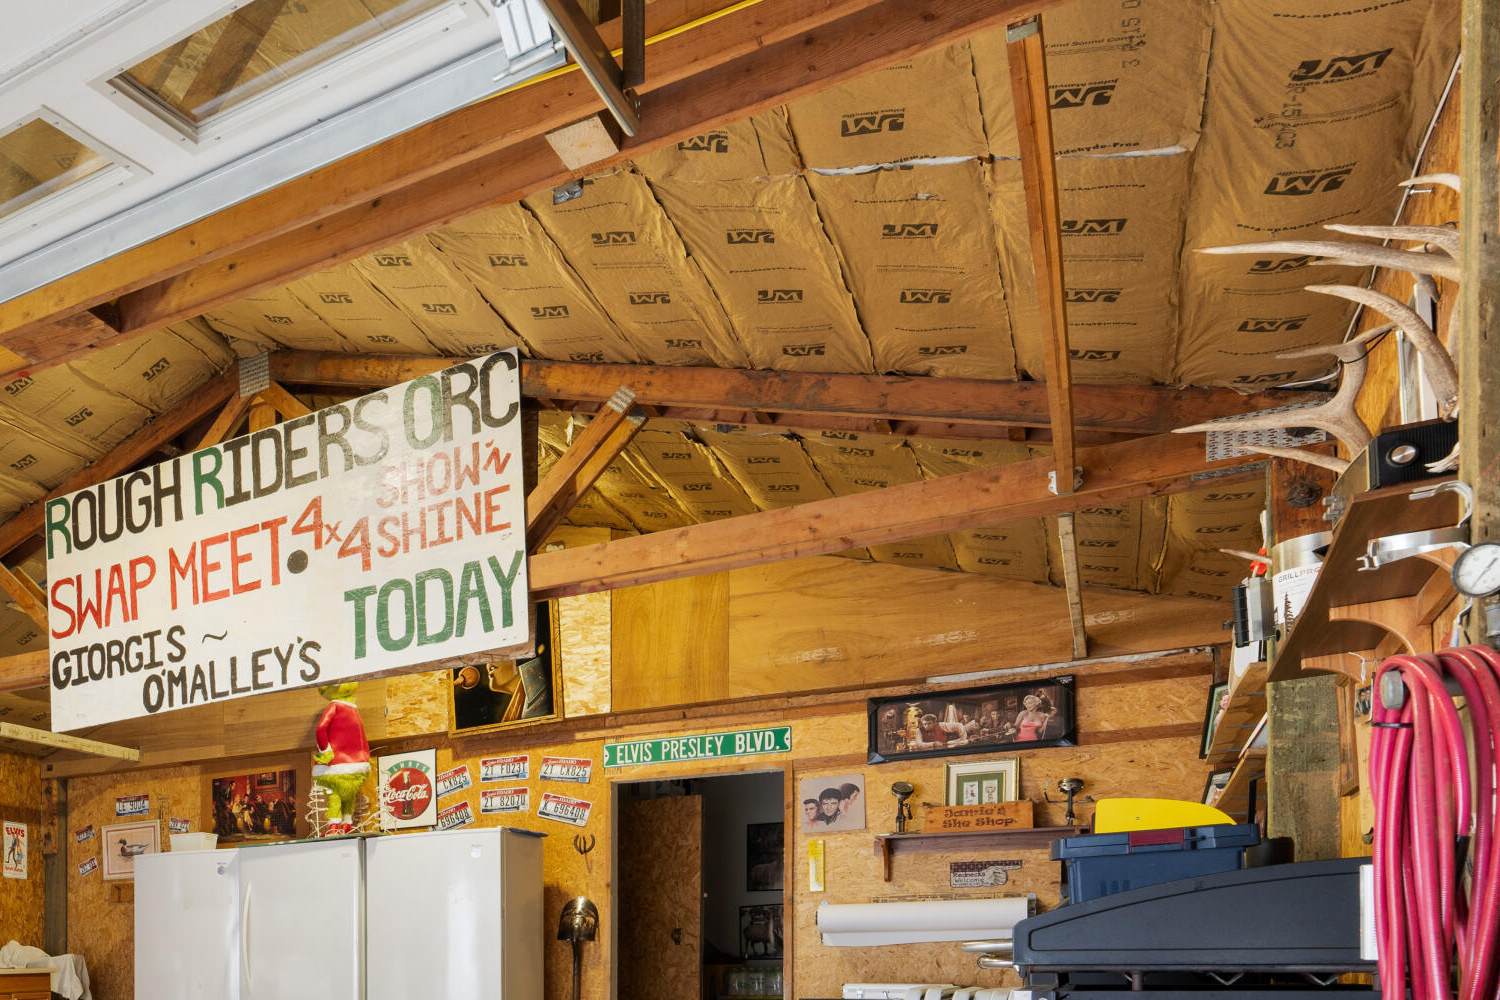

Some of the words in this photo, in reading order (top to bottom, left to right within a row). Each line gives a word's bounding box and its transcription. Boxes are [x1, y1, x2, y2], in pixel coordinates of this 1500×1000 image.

[1290, 48, 1394, 82] JM
[1050, 84, 1116, 110] JM
[841, 113, 905, 137] JM
[1263, 168, 1353, 196] JM
[882, 223, 938, 237] JM
[1061, 218, 1128, 233] JM
[592, 231, 636, 245] JM
[726, 231, 775, 244] JM
[629, 292, 671, 305] JM
[757, 289, 803, 302] JM
[900, 291, 952, 304] JM
[531, 305, 570, 318] JM
[142, 357, 170, 381] JM
[4, 375, 36, 395] JM
[65, 406, 93, 427] JM
[10, 454, 37, 471] JM
[46, 464, 183, 559] ROUGH
[193, 391, 390, 515] RIDERS
[403, 351, 518, 449] ORC
[376, 441, 480, 508] SHOW
[377, 484, 512, 559] SHINE
[50, 555, 156, 639] SWAP
[169, 515, 287, 611] MEET
[344, 550, 524, 661] TODAY
[52, 624, 187, 690] GIORGIS
[142, 636, 322, 714] O'MALLEY'S
[616, 743, 652, 765] ELVIS
[661, 736, 724, 761] PRESLEY
[735, 731, 781, 754] BLVD.
[560, 765, 587, 777] CX825
[5, 826, 26, 838] ELVIS
